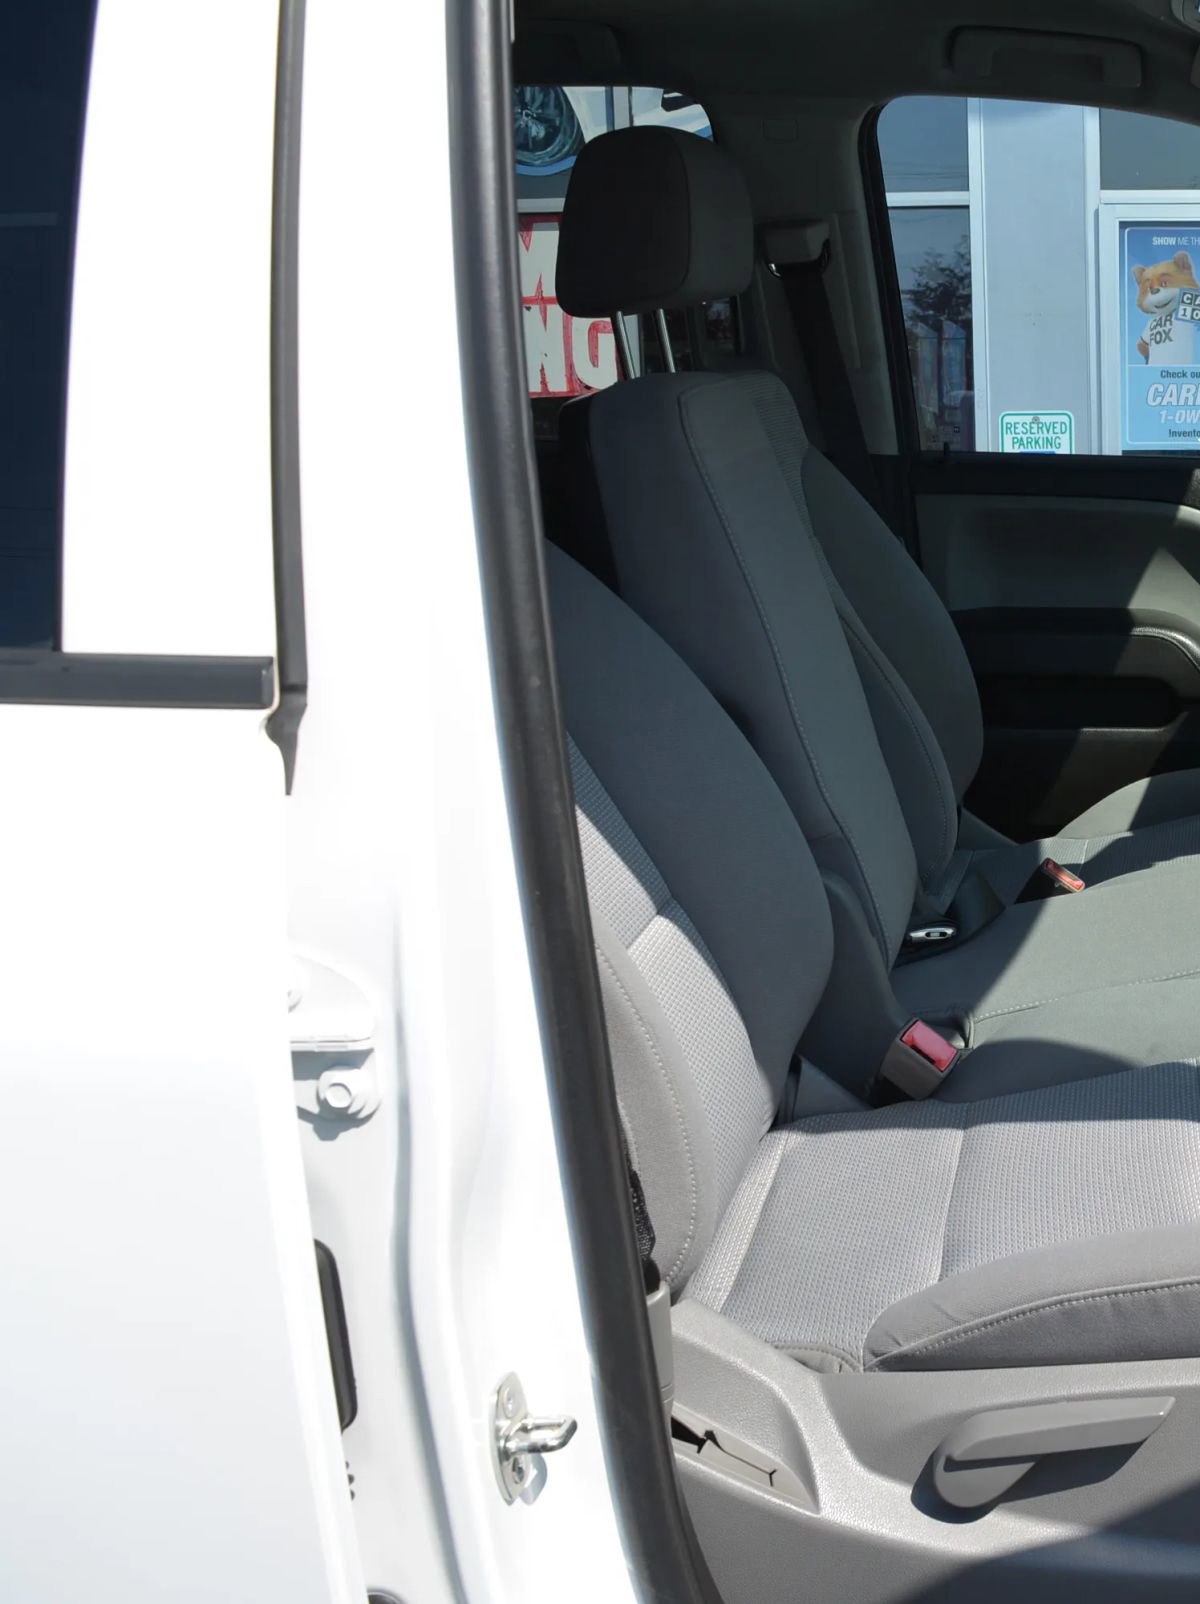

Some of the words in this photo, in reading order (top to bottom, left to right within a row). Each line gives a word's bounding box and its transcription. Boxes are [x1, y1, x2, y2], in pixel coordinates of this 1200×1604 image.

[1152, 236, 1176, 246] SHOW
[1177, 236, 1189, 246] ME
[1149, 313, 1173, 332] CAR
[1149, 328, 1173, 346] FOX
[1160, 369, 1188, 379] Check
[1005, 421, 1068, 435] RESERVED
[1011, 436, 1062, 450] PARKING
